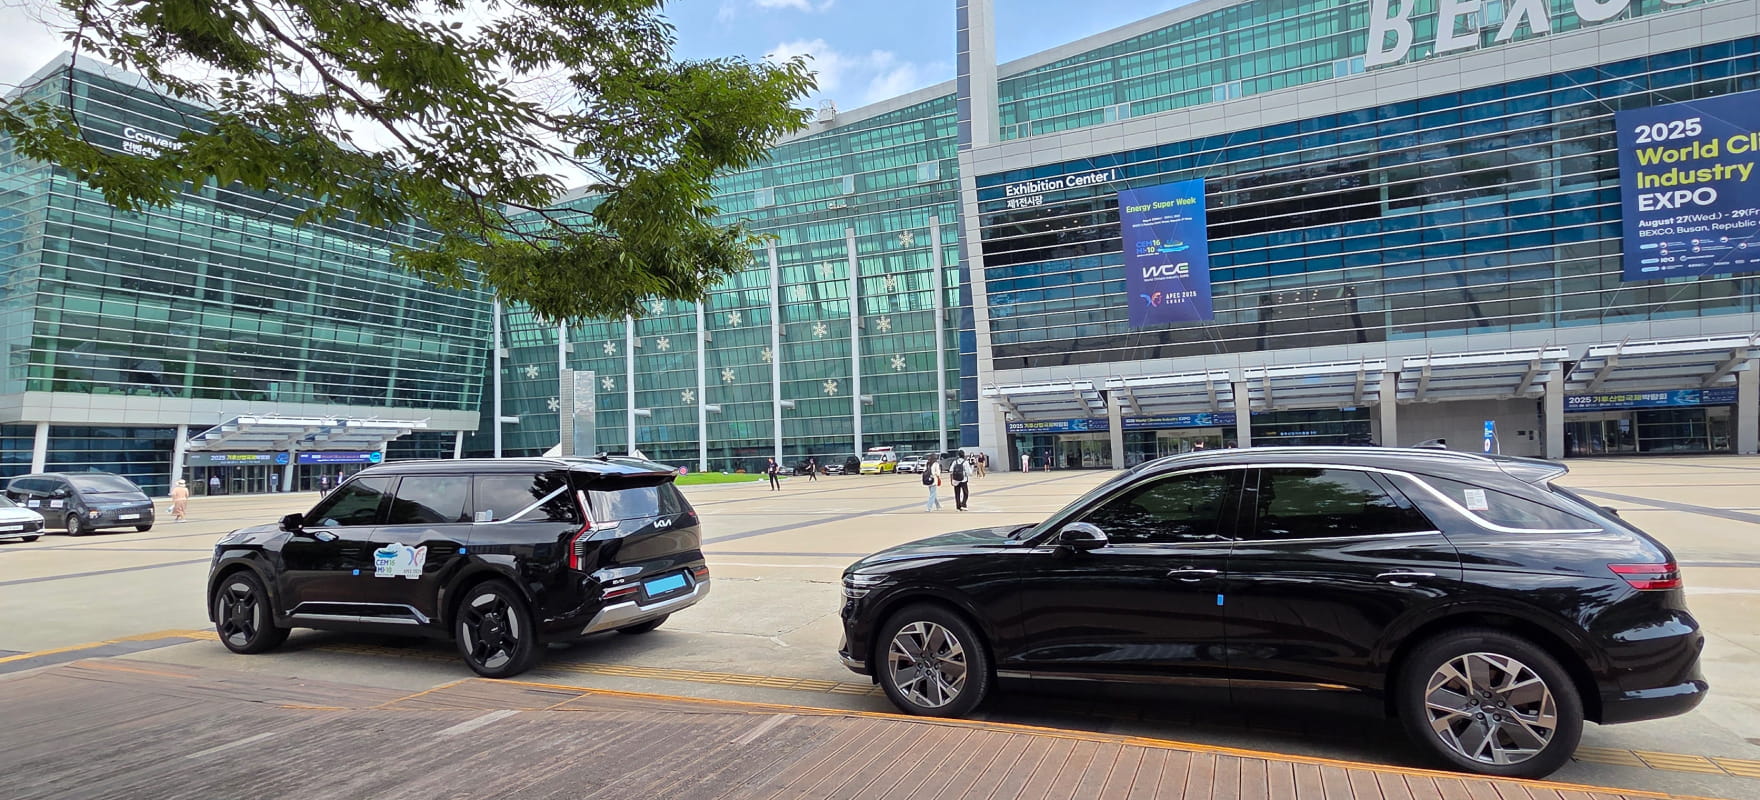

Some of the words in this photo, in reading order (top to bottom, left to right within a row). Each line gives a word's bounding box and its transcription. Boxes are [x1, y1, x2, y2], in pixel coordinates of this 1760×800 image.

[123, 127, 185, 151] Convent
[1634, 117, 1702, 144] 2025
[122, 140, 161, 159] 컨벤션
[1636, 138, 1719, 166] World
[1005, 179, 1064, 197] Exhibition
[1066, 171, 1109, 187] Center
[1637, 162, 1754, 189] Industry
[1007, 195, 1043, 209] 제1전시장
[1126, 203, 1151, 213] Energy
[1152, 200, 1175, 209] Super
[1176, 197, 1197, 206] Week
[1638, 187, 1717, 212] EXPO
[1638, 217, 1674, 228] August
[1676, 212, 1722, 224] 27(Wed.)
[1711, 220, 1757, 231] Republic
[1142, 262, 1189, 278] WCE
[1568, 396, 1592, 404] 2025
